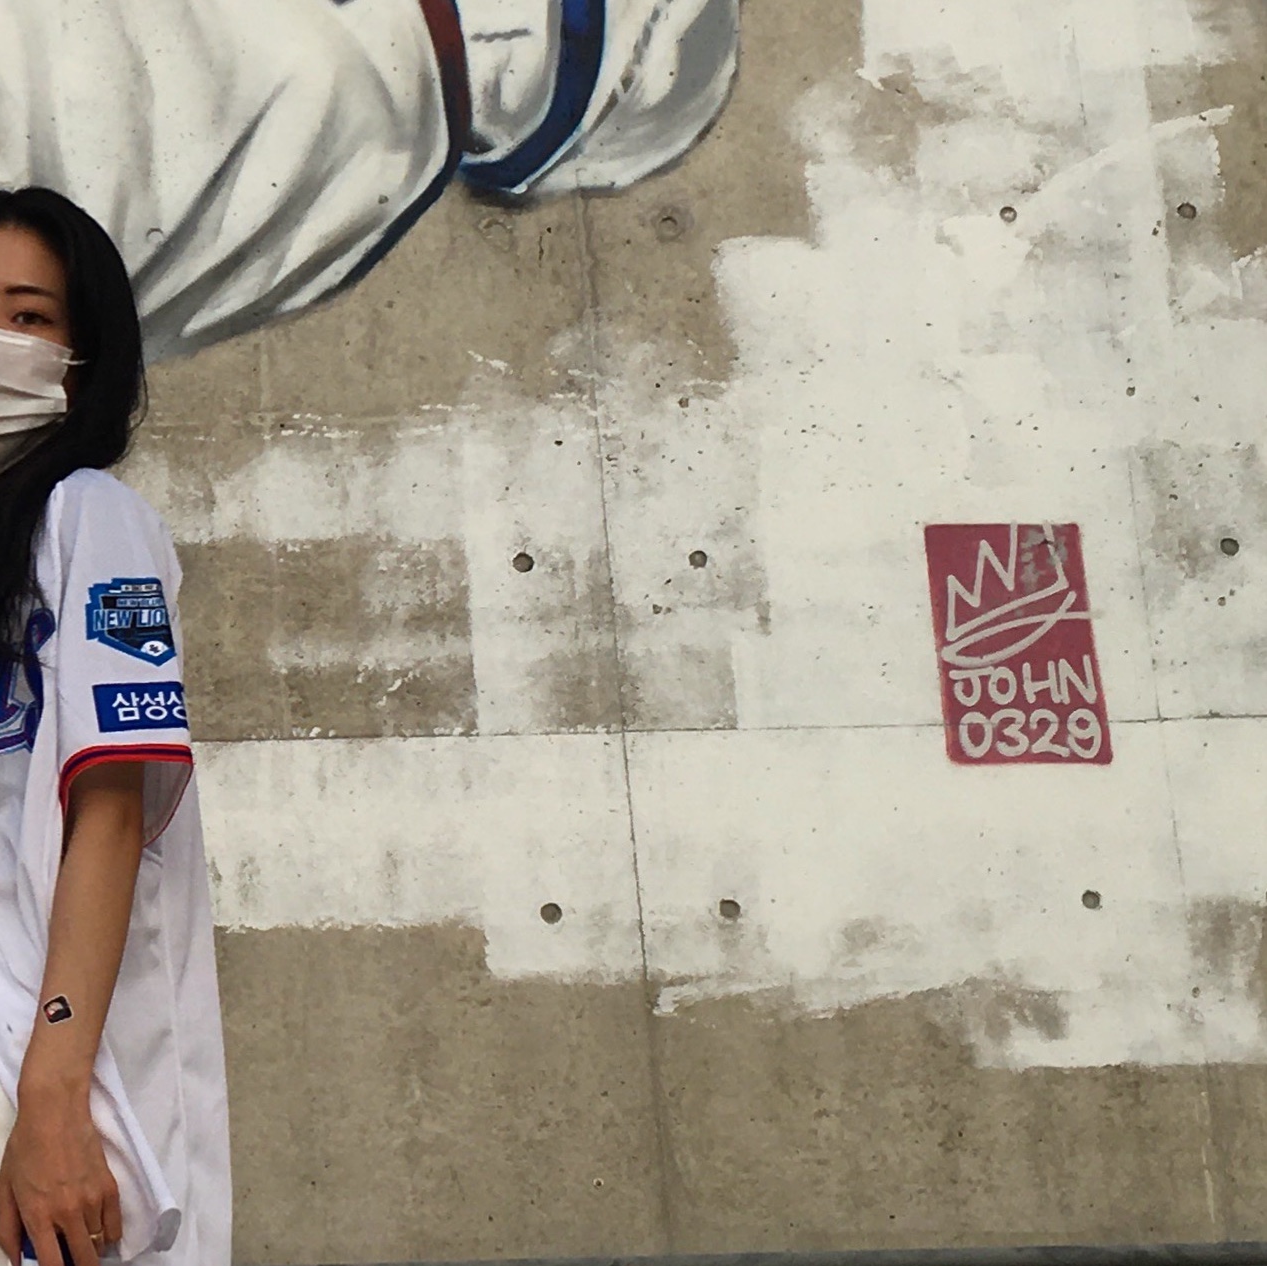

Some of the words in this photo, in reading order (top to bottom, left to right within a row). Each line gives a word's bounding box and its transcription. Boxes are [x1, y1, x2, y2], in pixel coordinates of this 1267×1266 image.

[93, 609, 133, 632] NEW
[136, 608, 170, 628] LIO
[948, 654, 1098, 706] JOHN
[958, 708, 1102, 759] 0329
